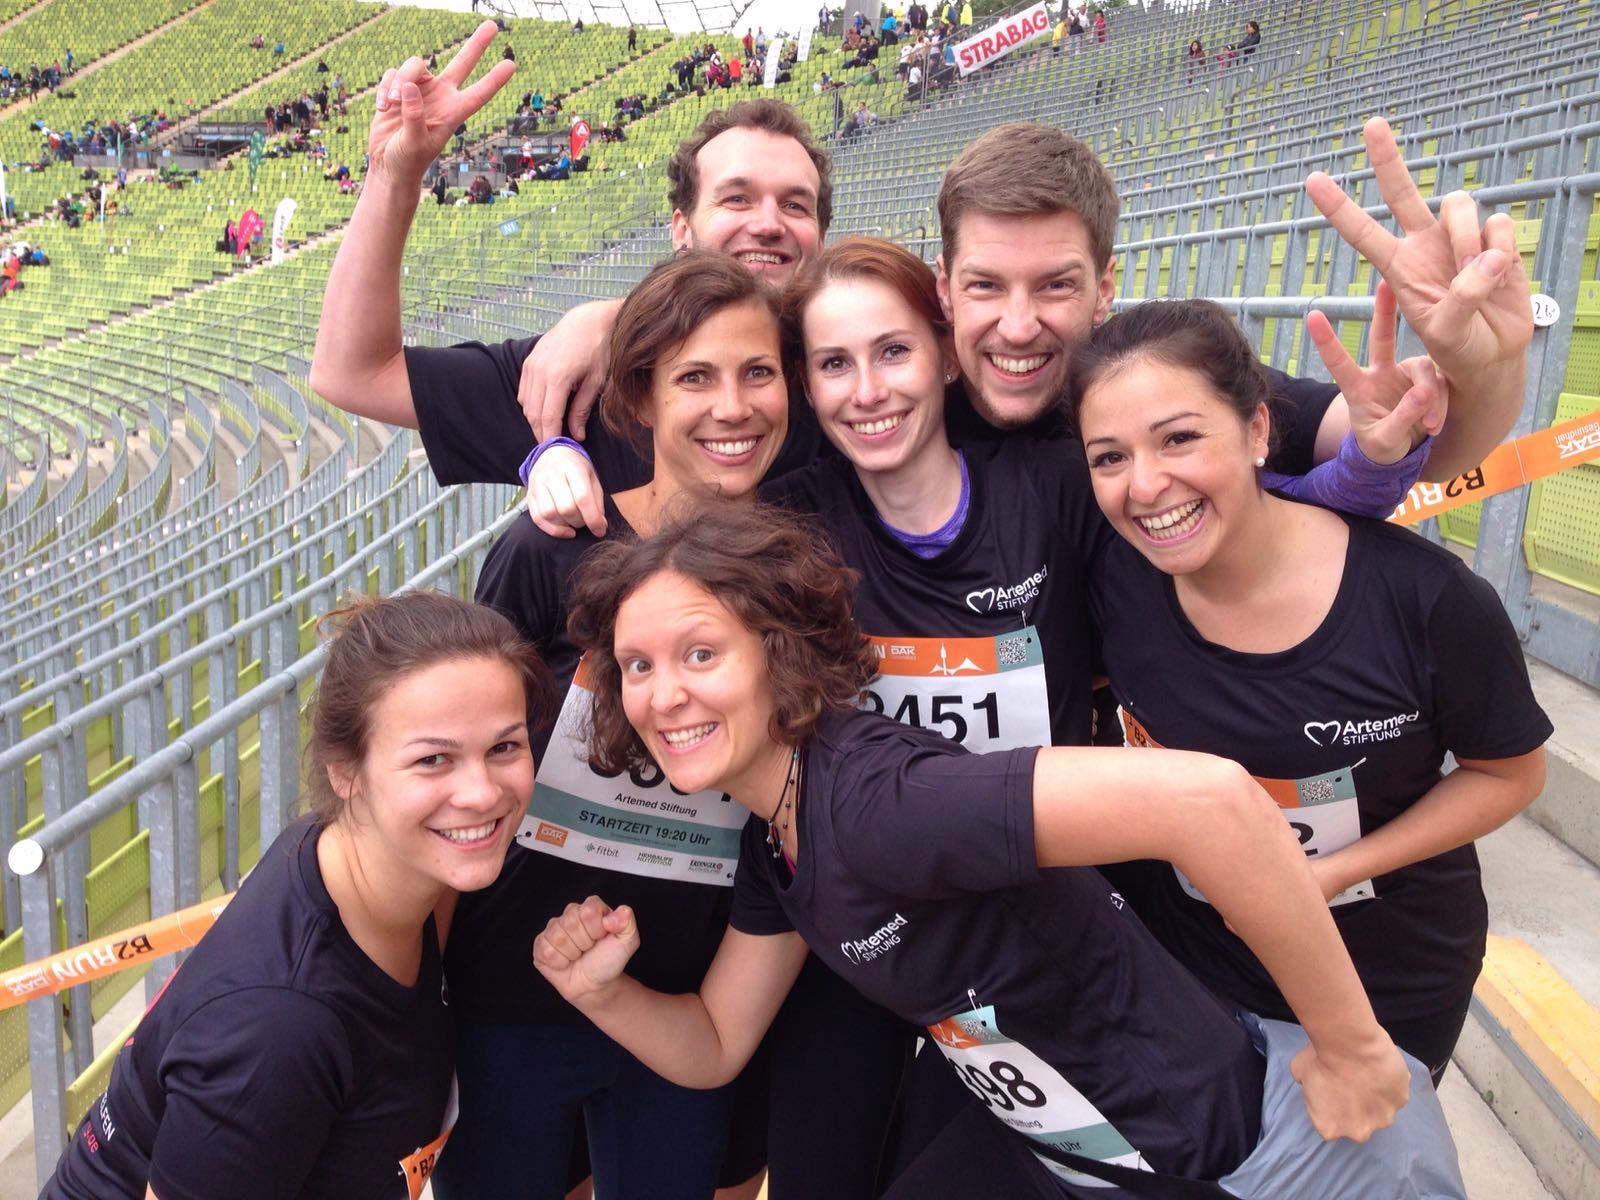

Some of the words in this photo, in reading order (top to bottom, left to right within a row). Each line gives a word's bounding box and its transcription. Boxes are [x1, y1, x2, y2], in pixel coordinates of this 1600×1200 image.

[960, 9, 1048, 68] STRABAG
[996, 564, 1048, 602] Artemed
[996, 587, 1040, 611] STIFTUNG
[891, 645, 916, 656] DAK
[1342, 710, 1420, 736] Artemed
[1342, 727, 1402, 746] STIFTUNG
[614, 792, 658, 809] Artemed
[659, 801, 698, 817] Stiftung
[578, 809, 653, 836] STARTZEIT
[655, 826, 688, 843] 19:20
[689, 831, 712, 846] Uhr
[596, 845, 620, 858] fitbit
[853, 912, 909, 954] Artemed
[50, 933, 154, 982] B2RUN
[862, 934, 901, 962] STIFTUNG
[1063, 1141, 1082, 1152] Uhr
